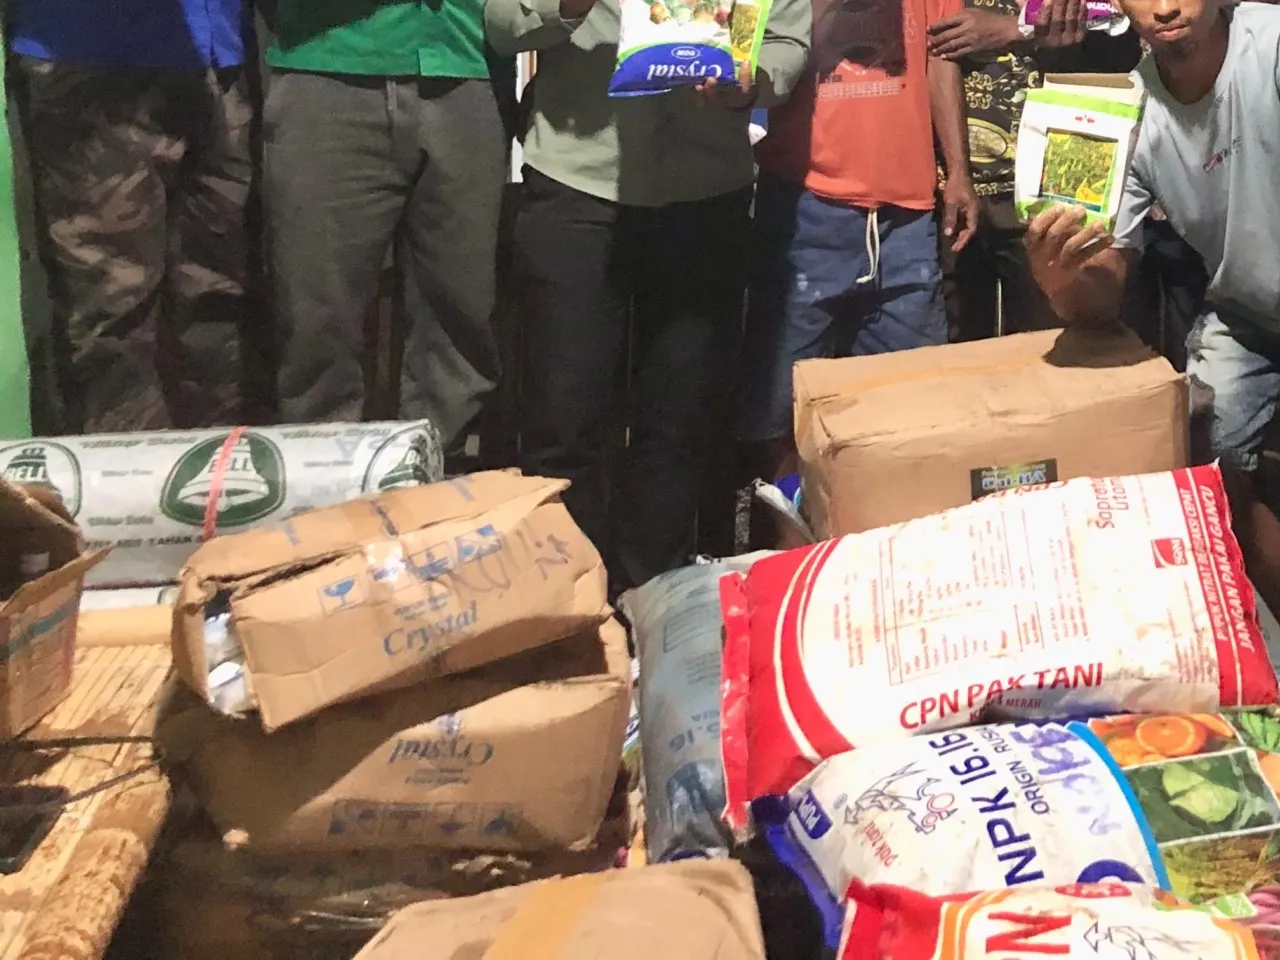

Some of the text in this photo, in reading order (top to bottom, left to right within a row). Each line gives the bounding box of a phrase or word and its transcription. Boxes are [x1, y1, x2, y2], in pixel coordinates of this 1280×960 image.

[646, 60, 722, 80] Crystal
[1179, 488, 1196, 518] CEPAT
[1200, 485, 1256, 653] JANGAN PAKAI GANCU
[382, 599, 479, 657] Crystal
[899, 687, 960, 731] CPN
[966, 673, 1026, 709] PAK
[1032, 661, 1105, 690] TANI
[388, 736, 495, 766] Crystal
[1006, 760, 1051, 816] ORIGIN
[970, 785, 1045, 887] NPK
